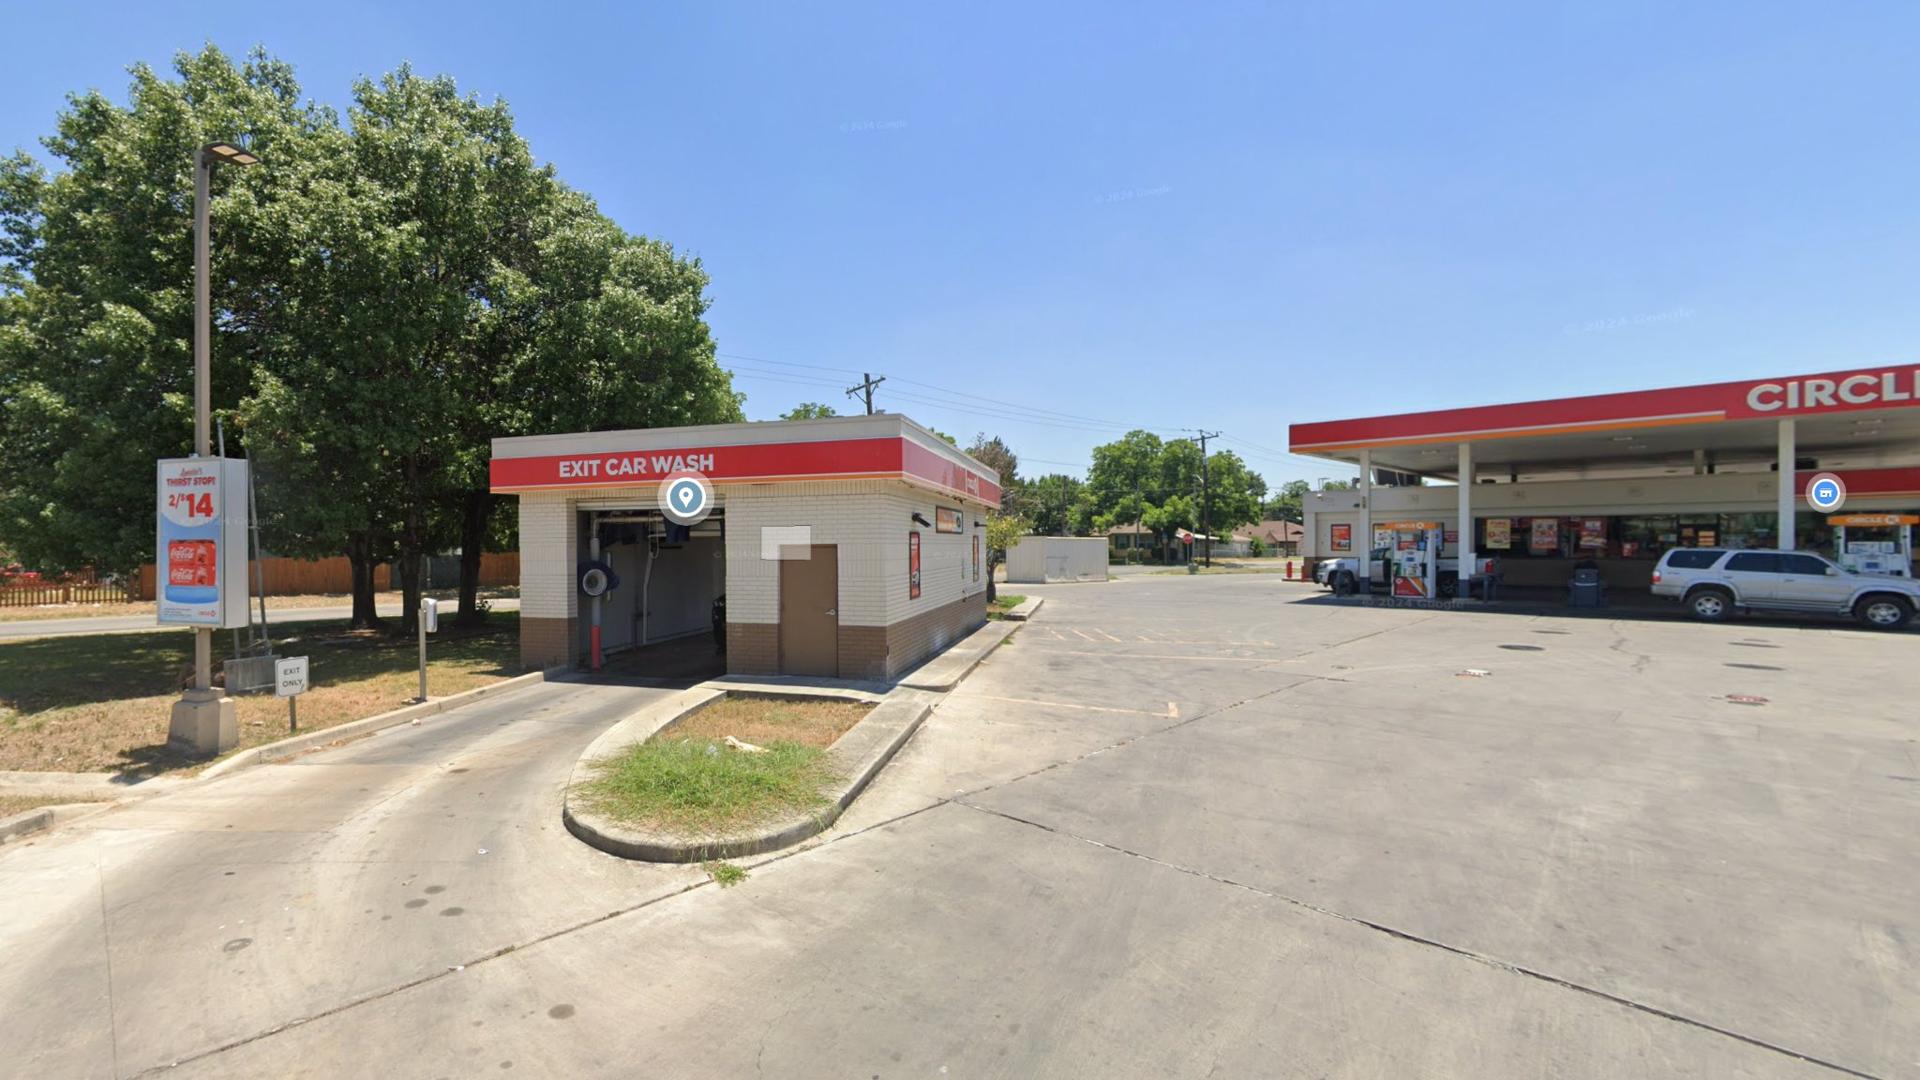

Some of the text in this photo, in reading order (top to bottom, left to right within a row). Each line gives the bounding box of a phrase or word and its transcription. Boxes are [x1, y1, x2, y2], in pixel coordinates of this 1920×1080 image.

[1747, 369, 1920, 411] CIRCL
[559, 453, 715, 478] EXIT CAR WASH
[166, 477, 192, 487] THIRST
[283, 666, 301, 676] EXIT
[282, 678, 304, 688] ONLY
